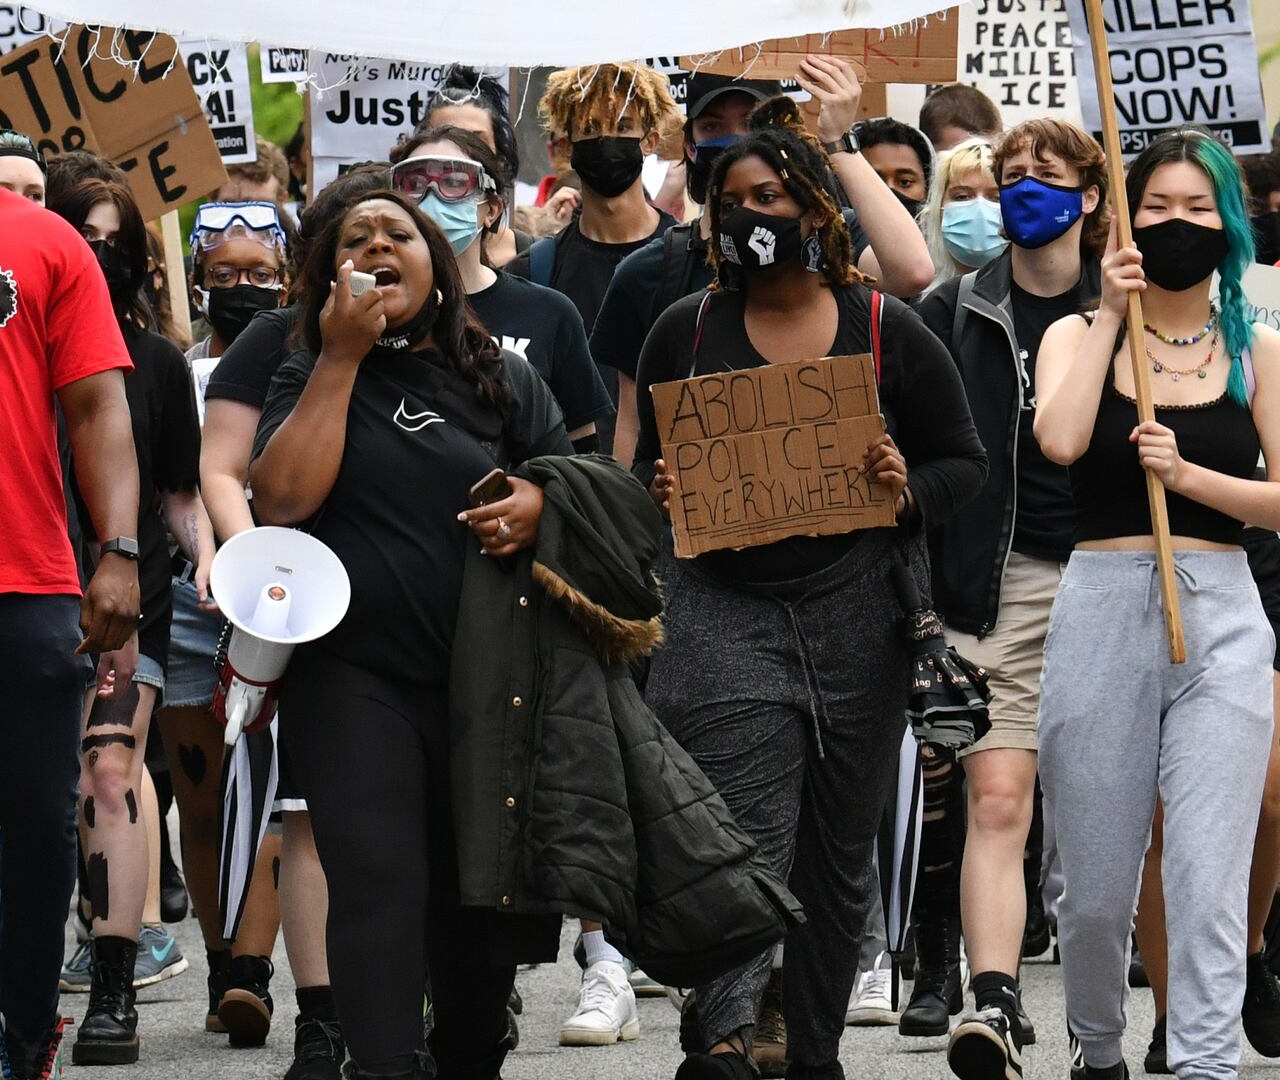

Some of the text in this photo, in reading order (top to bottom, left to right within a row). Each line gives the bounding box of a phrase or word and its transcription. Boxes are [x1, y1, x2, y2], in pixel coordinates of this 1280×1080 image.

[976, 21, 1073, 48] PEACE
[1110, 43, 1228, 85] COPS
[669, 360, 872, 441] ABOLISH
[676, 422, 846, 491] POLICE
[680, 467, 886, 534] EVERYWHERE
